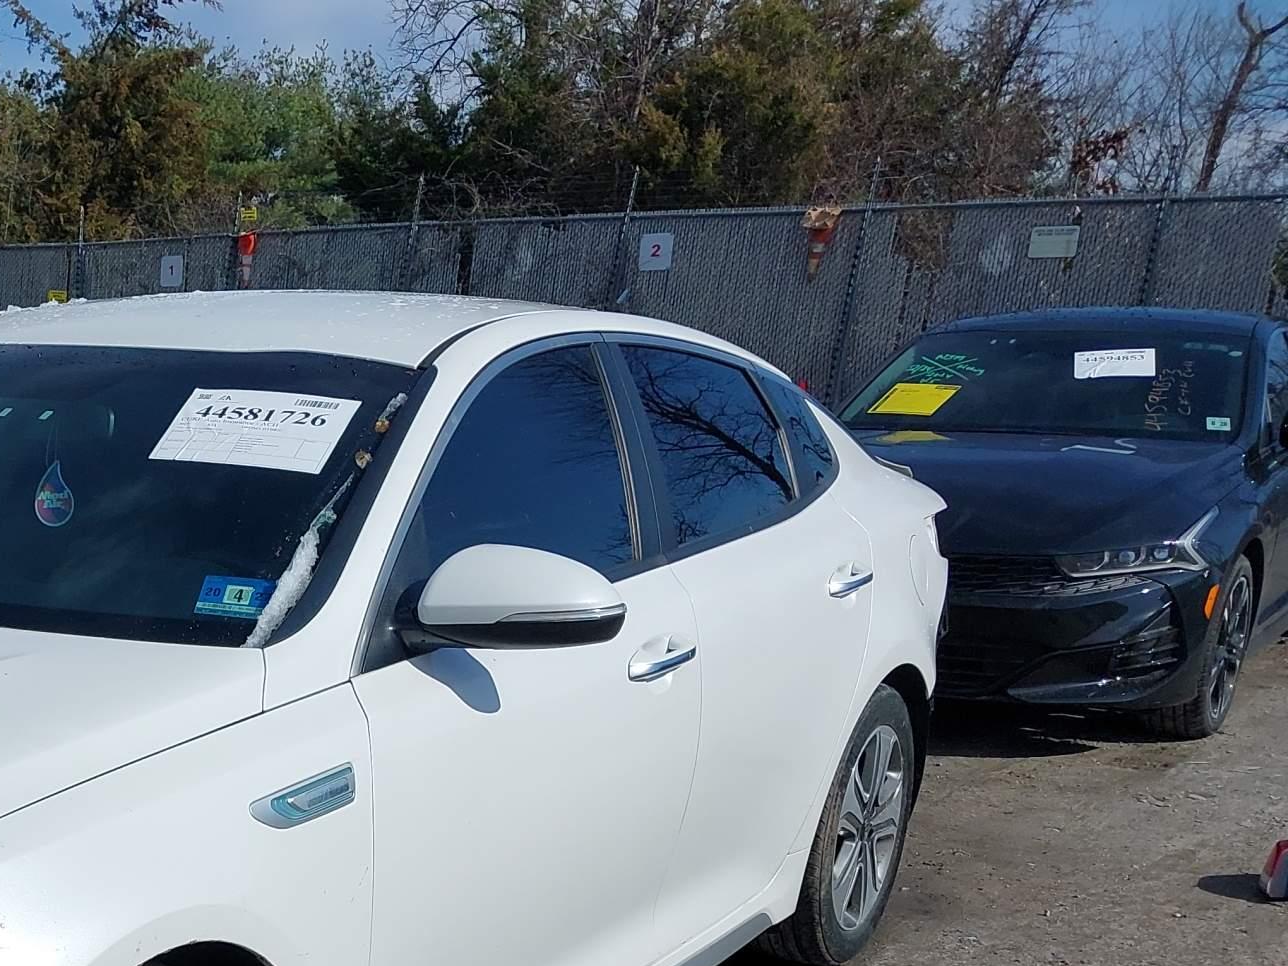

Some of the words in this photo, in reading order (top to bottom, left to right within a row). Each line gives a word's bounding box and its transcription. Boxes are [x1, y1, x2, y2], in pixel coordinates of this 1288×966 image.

[650, 244, 661, 257] 2
[1082, 354, 1145, 363] 44594853
[196, 405, 328, 427] 44581726
[205, 587, 221, 597] 20
[233, 589, 244, 603] 4
